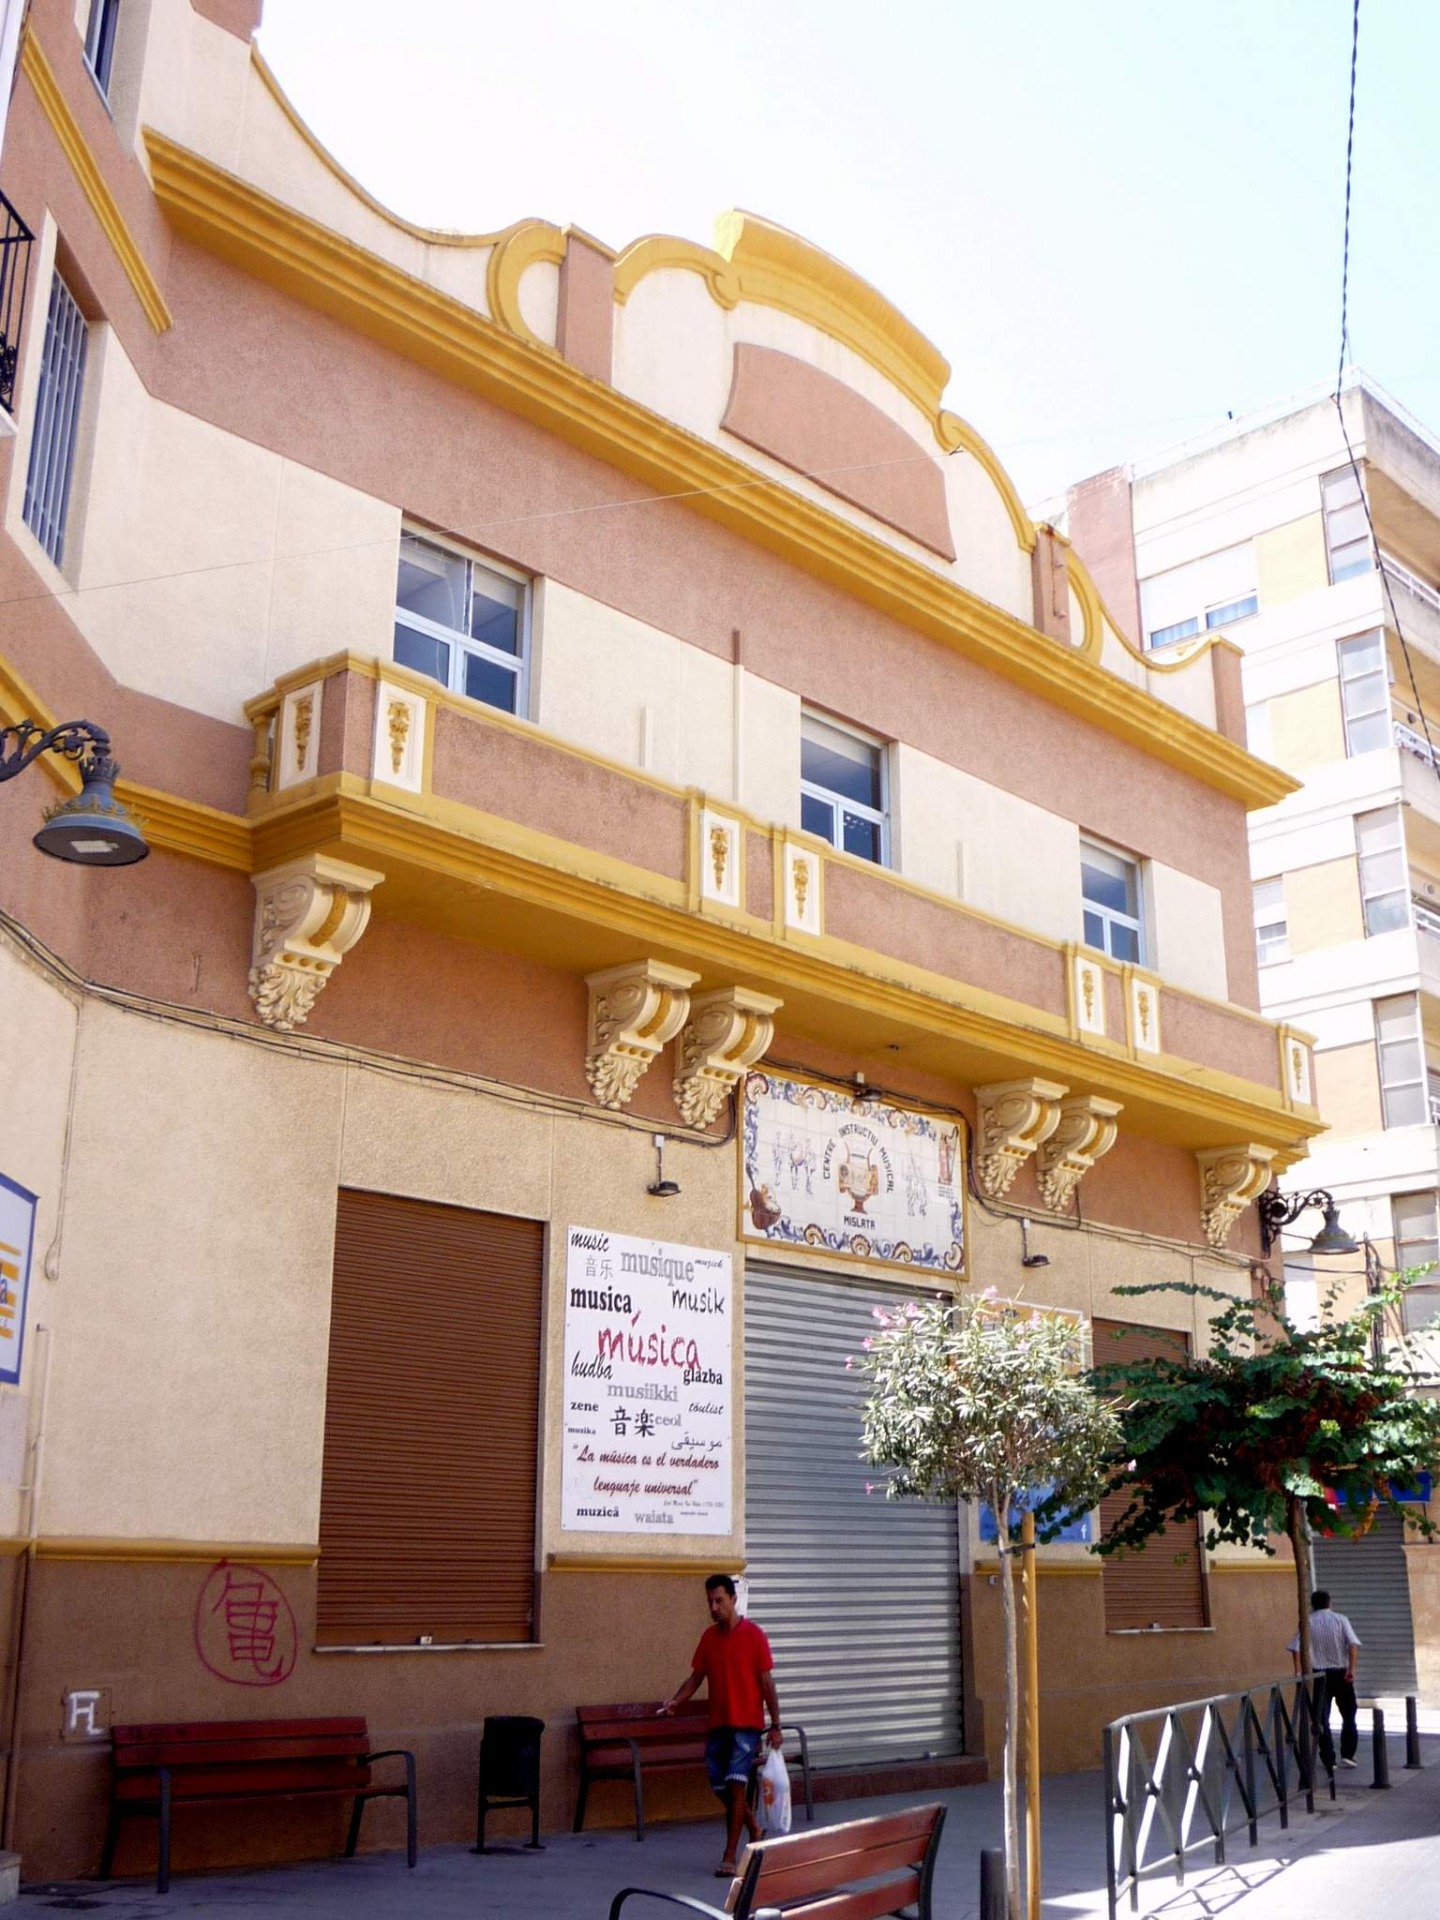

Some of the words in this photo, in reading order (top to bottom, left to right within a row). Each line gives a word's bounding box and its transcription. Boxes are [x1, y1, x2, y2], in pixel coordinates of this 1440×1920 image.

[823, 1138, 837, 1180] CENTRE
[879, 1146, 894, 1193] MUSICAL
[843, 1215, 876, 1230] MISLATA
[570, 1231, 611, 1252] music
[585, 1254, 614, 1280] 音乐
[620, 1248, 695, 1287] musique
[570, 1285, 632, 1314] musica
[672, 1287, 725, 1315] musik
[598, 1310, 701, 1370] música
[571, 1350, 614, 1380] hudba
[683, 1366, 723, 1386] glazba
[607, 1383, 678, 1403] musiikki
[570, 1401, 599, 1412] zene
[610, 1405, 656, 1438] 音楽
[654, 1414, 682, 1427] ceol
[599, 1450, 637, 1467] música
[641, 1455, 652, 1466] es
[656, 1451, 666, 1467] el
[669, 1452, 720, 1470] verdadero
[593, 1475, 641, 1498] lenguaje
